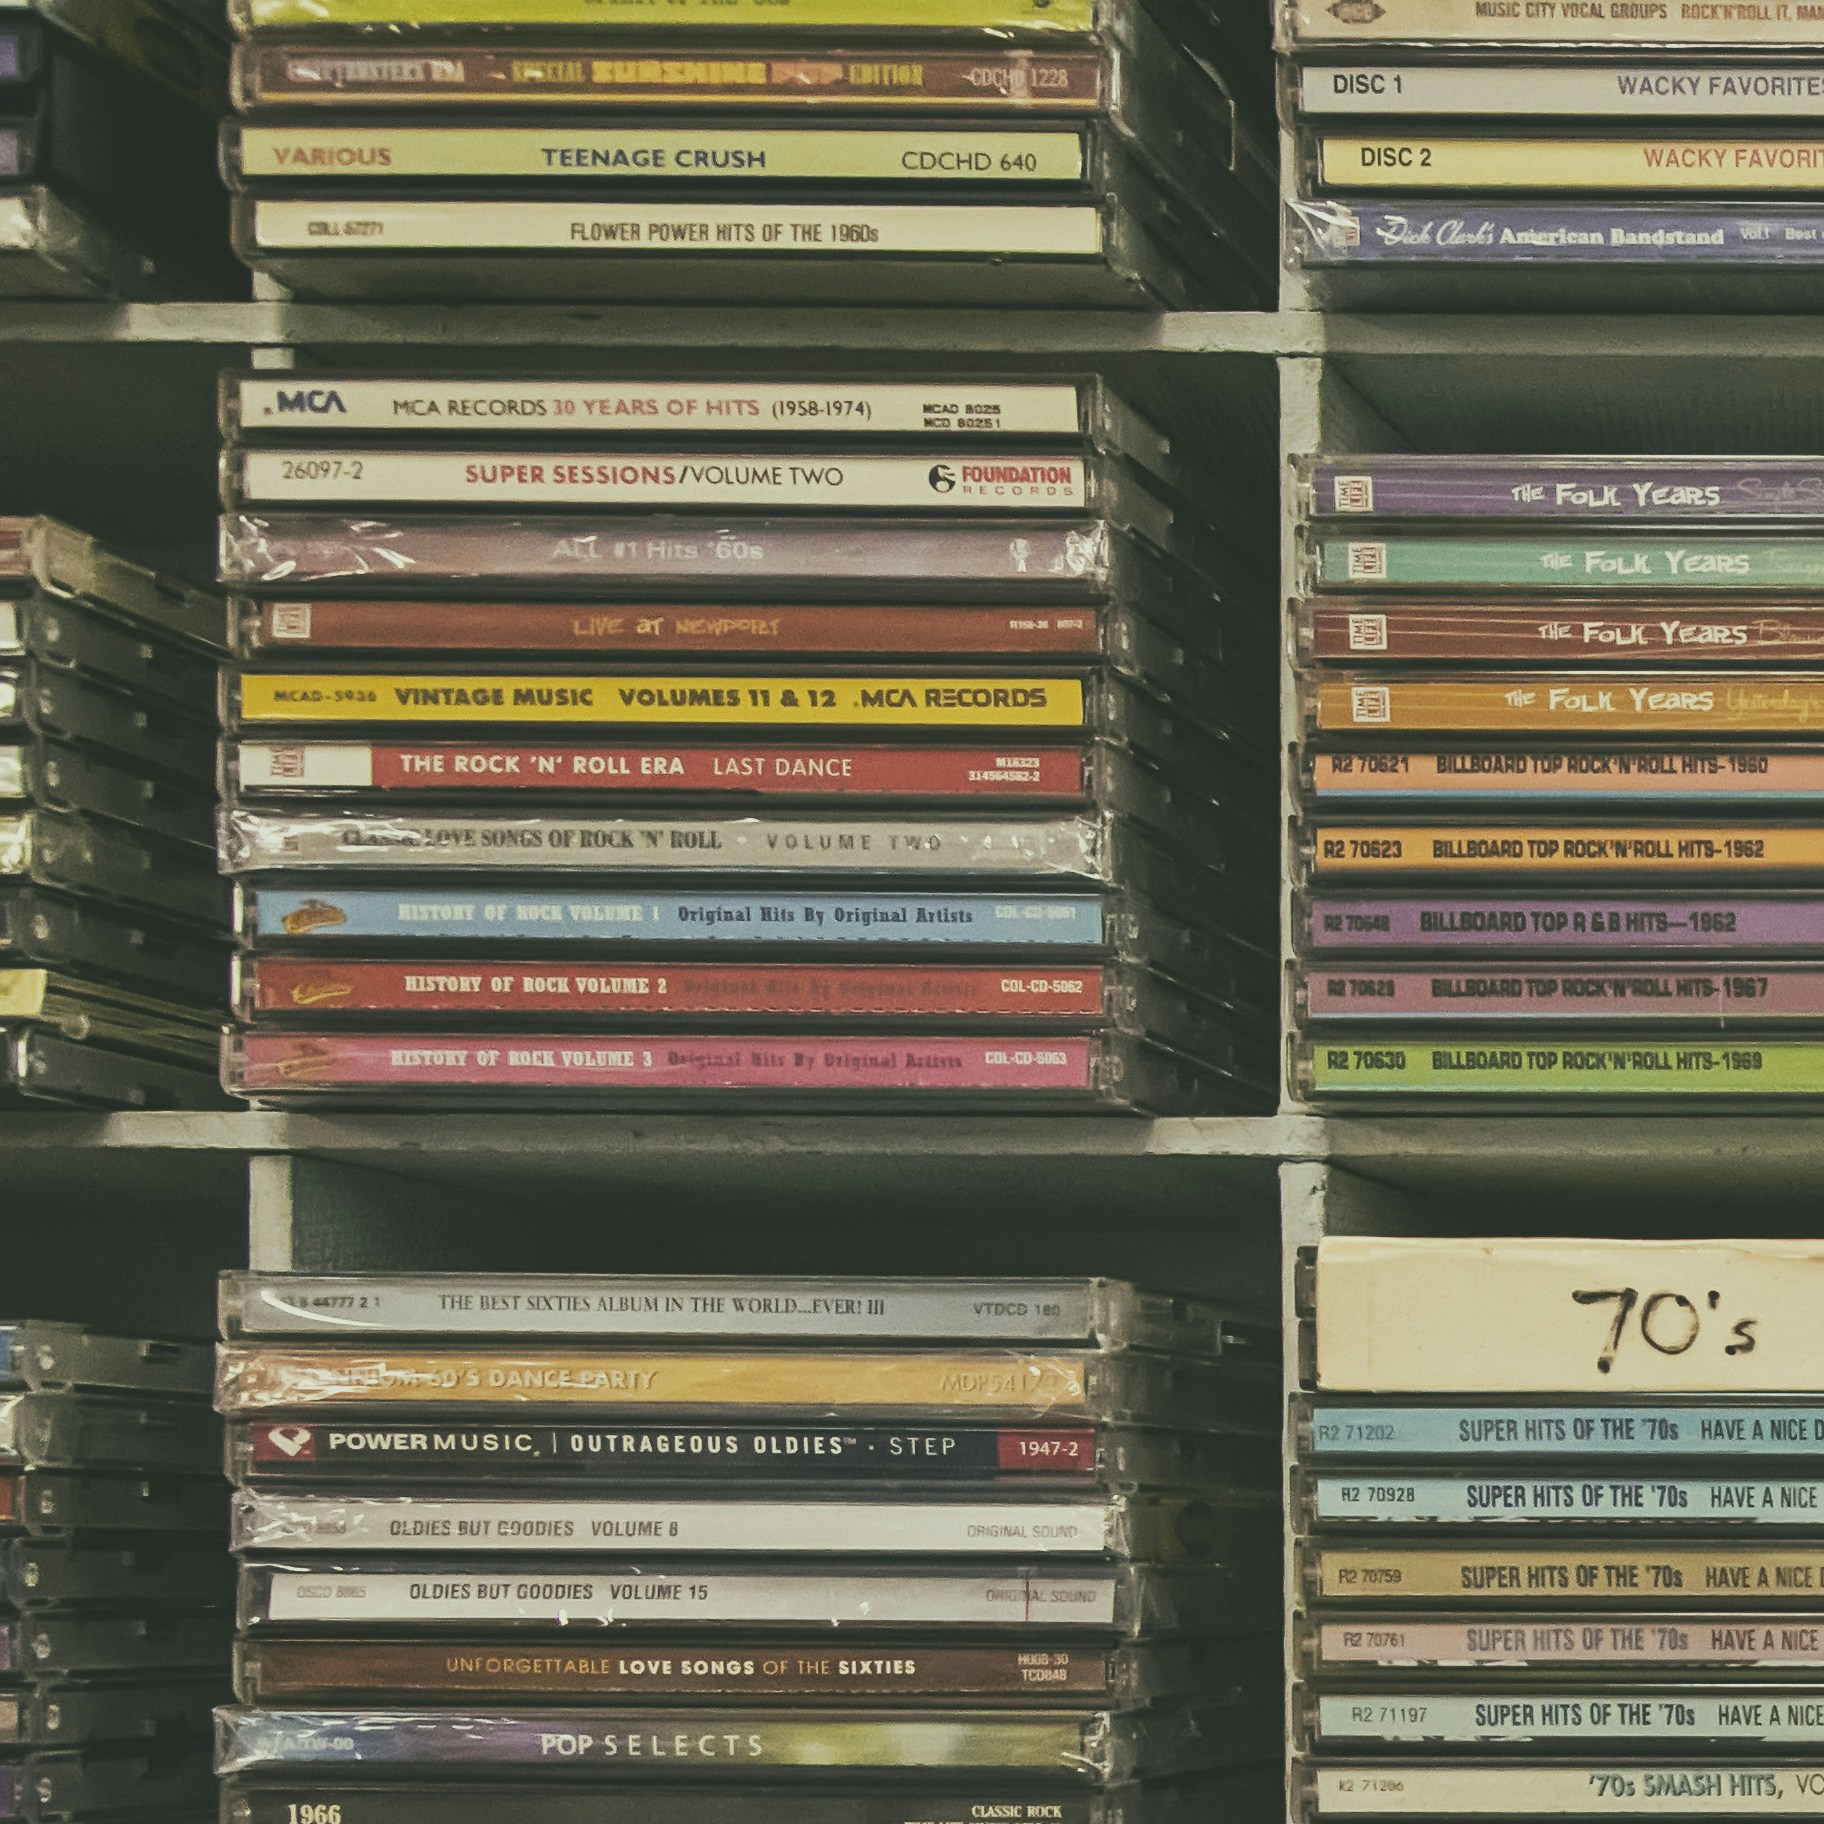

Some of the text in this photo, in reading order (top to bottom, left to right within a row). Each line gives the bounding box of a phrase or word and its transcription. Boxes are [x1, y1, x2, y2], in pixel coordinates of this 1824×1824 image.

[1333, 73, 1385, 95] DISC
[1394, 73, 1402, 94] 1
[1617, 75, 1701, 96] WACKY
[273, 146, 1038, 173] VARIOUS TEENAGE CRUSH CDCHD 640
[282, 459, 1073, 487] 26097-2 SUPER SESSIONS/VOLUME TWO FOUNDATION
[962, 485, 1074, 497] RECORDS
[1512, 483, 1546, 503] THE
[1323, 839, 1344, 859] R2
[1351, 839, 1403, 859] 70623
[1433, 839, 1521, 859] BILLBOARD
[1526, 839, 1557, 859] TOP
[1572, 1288, 1756, 1374] 70's
[446, 1657, 916, 1676] UNFORGETTABLE LOVE SONGS OF THE SIXTIES
[541, 1732, 764, 1758] POP SELECTS
[1589, 1772, 1636, 1798] '70s
[1643, 1772, 1719, 1797] SMASH
[1722, 1772, 1783, 1799] HITS,
[970, 1804, 1063, 1819] CLASSIC ROCK
